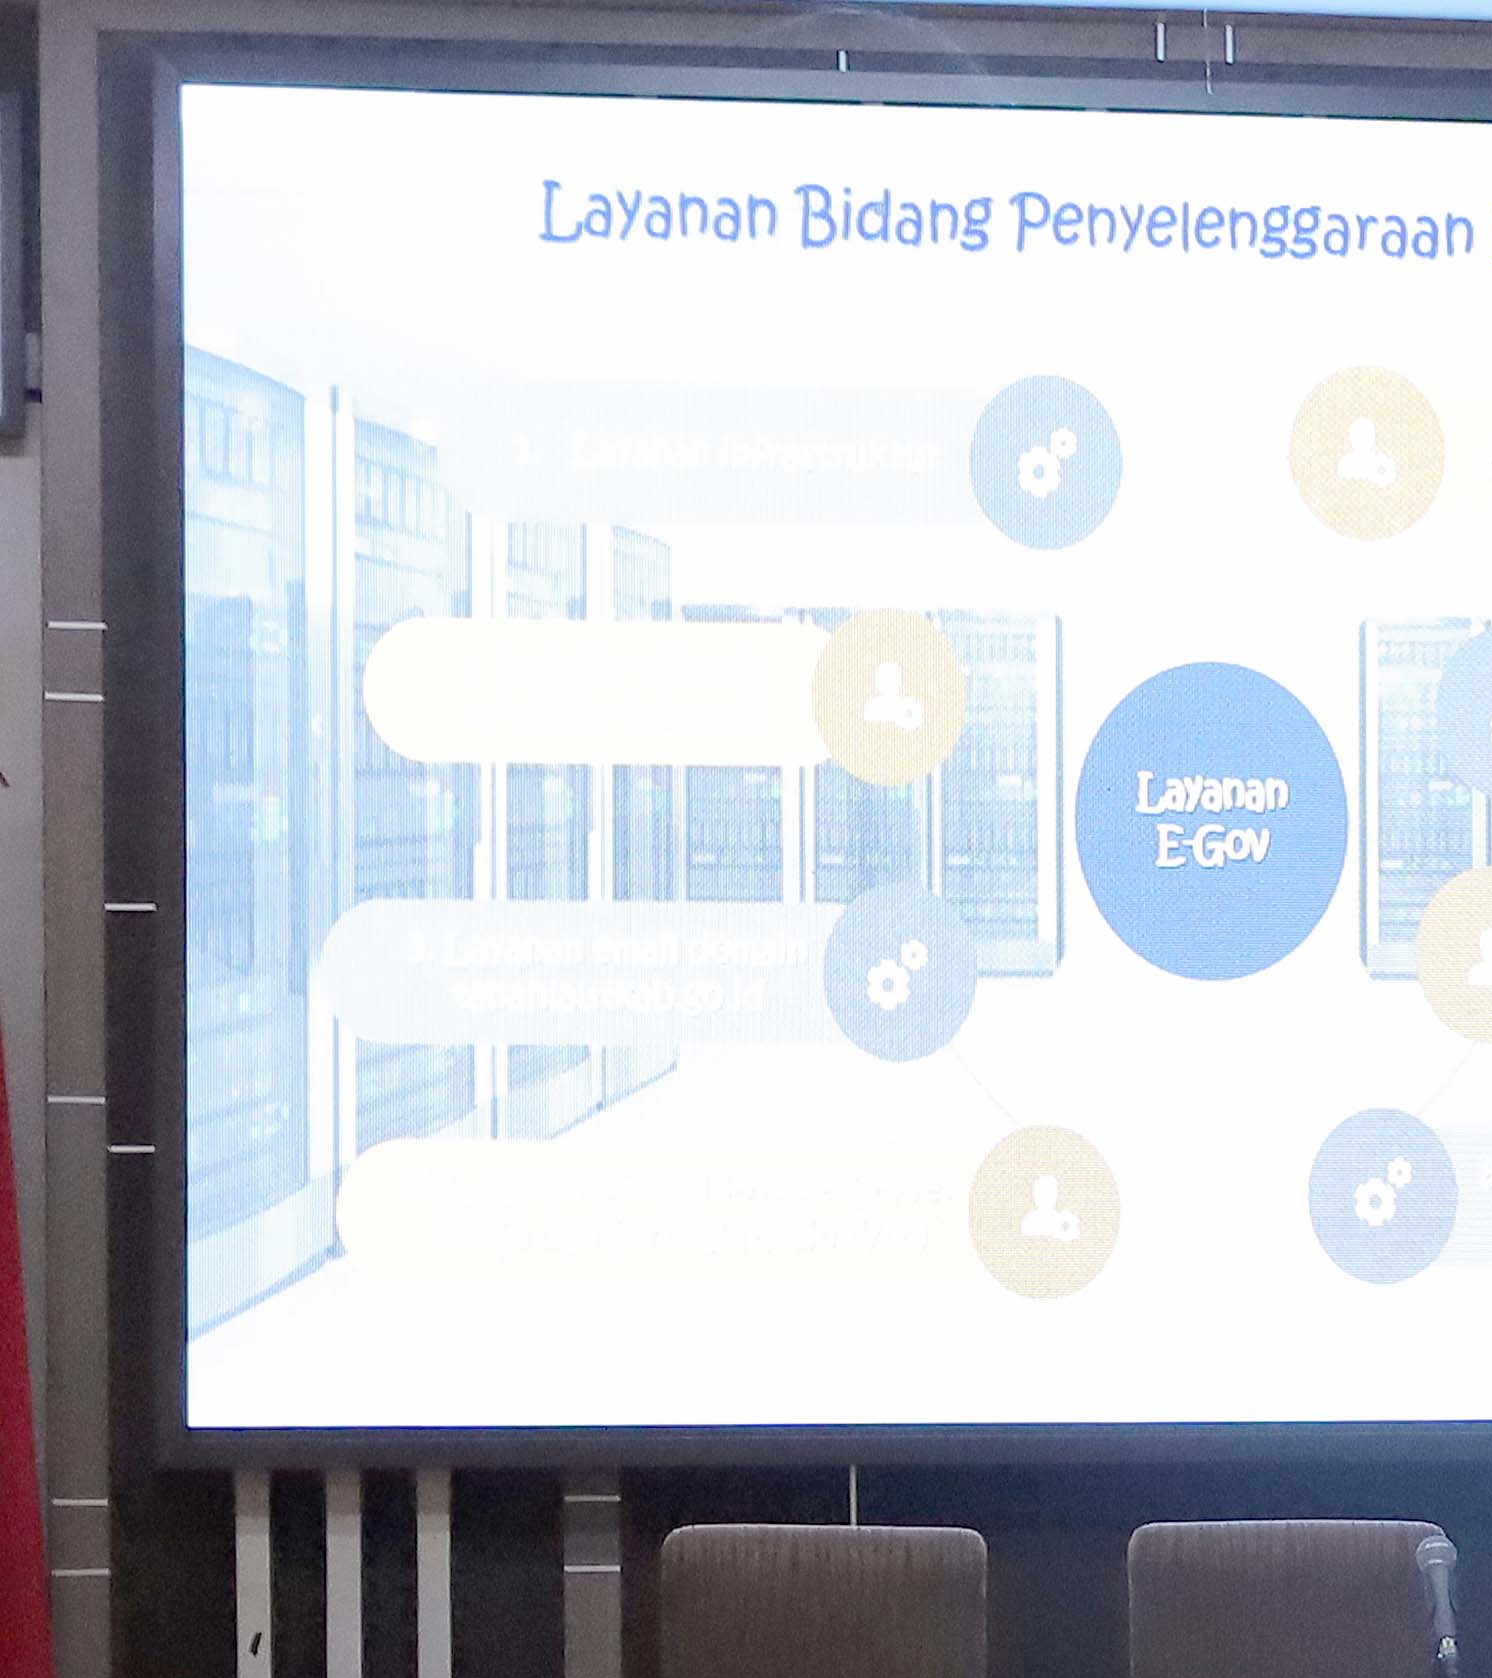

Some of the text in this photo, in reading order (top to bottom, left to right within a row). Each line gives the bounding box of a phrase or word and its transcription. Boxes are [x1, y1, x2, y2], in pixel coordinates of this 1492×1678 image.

[539, 179, 778, 244] Layanan
[794, 184, 993, 252] Bidang
[1009, 191, 1474, 261] Penyelenggaraan
[1135, 770, 1289, 814] Layanan
[1155, 823, 1270, 868] E-Gov
